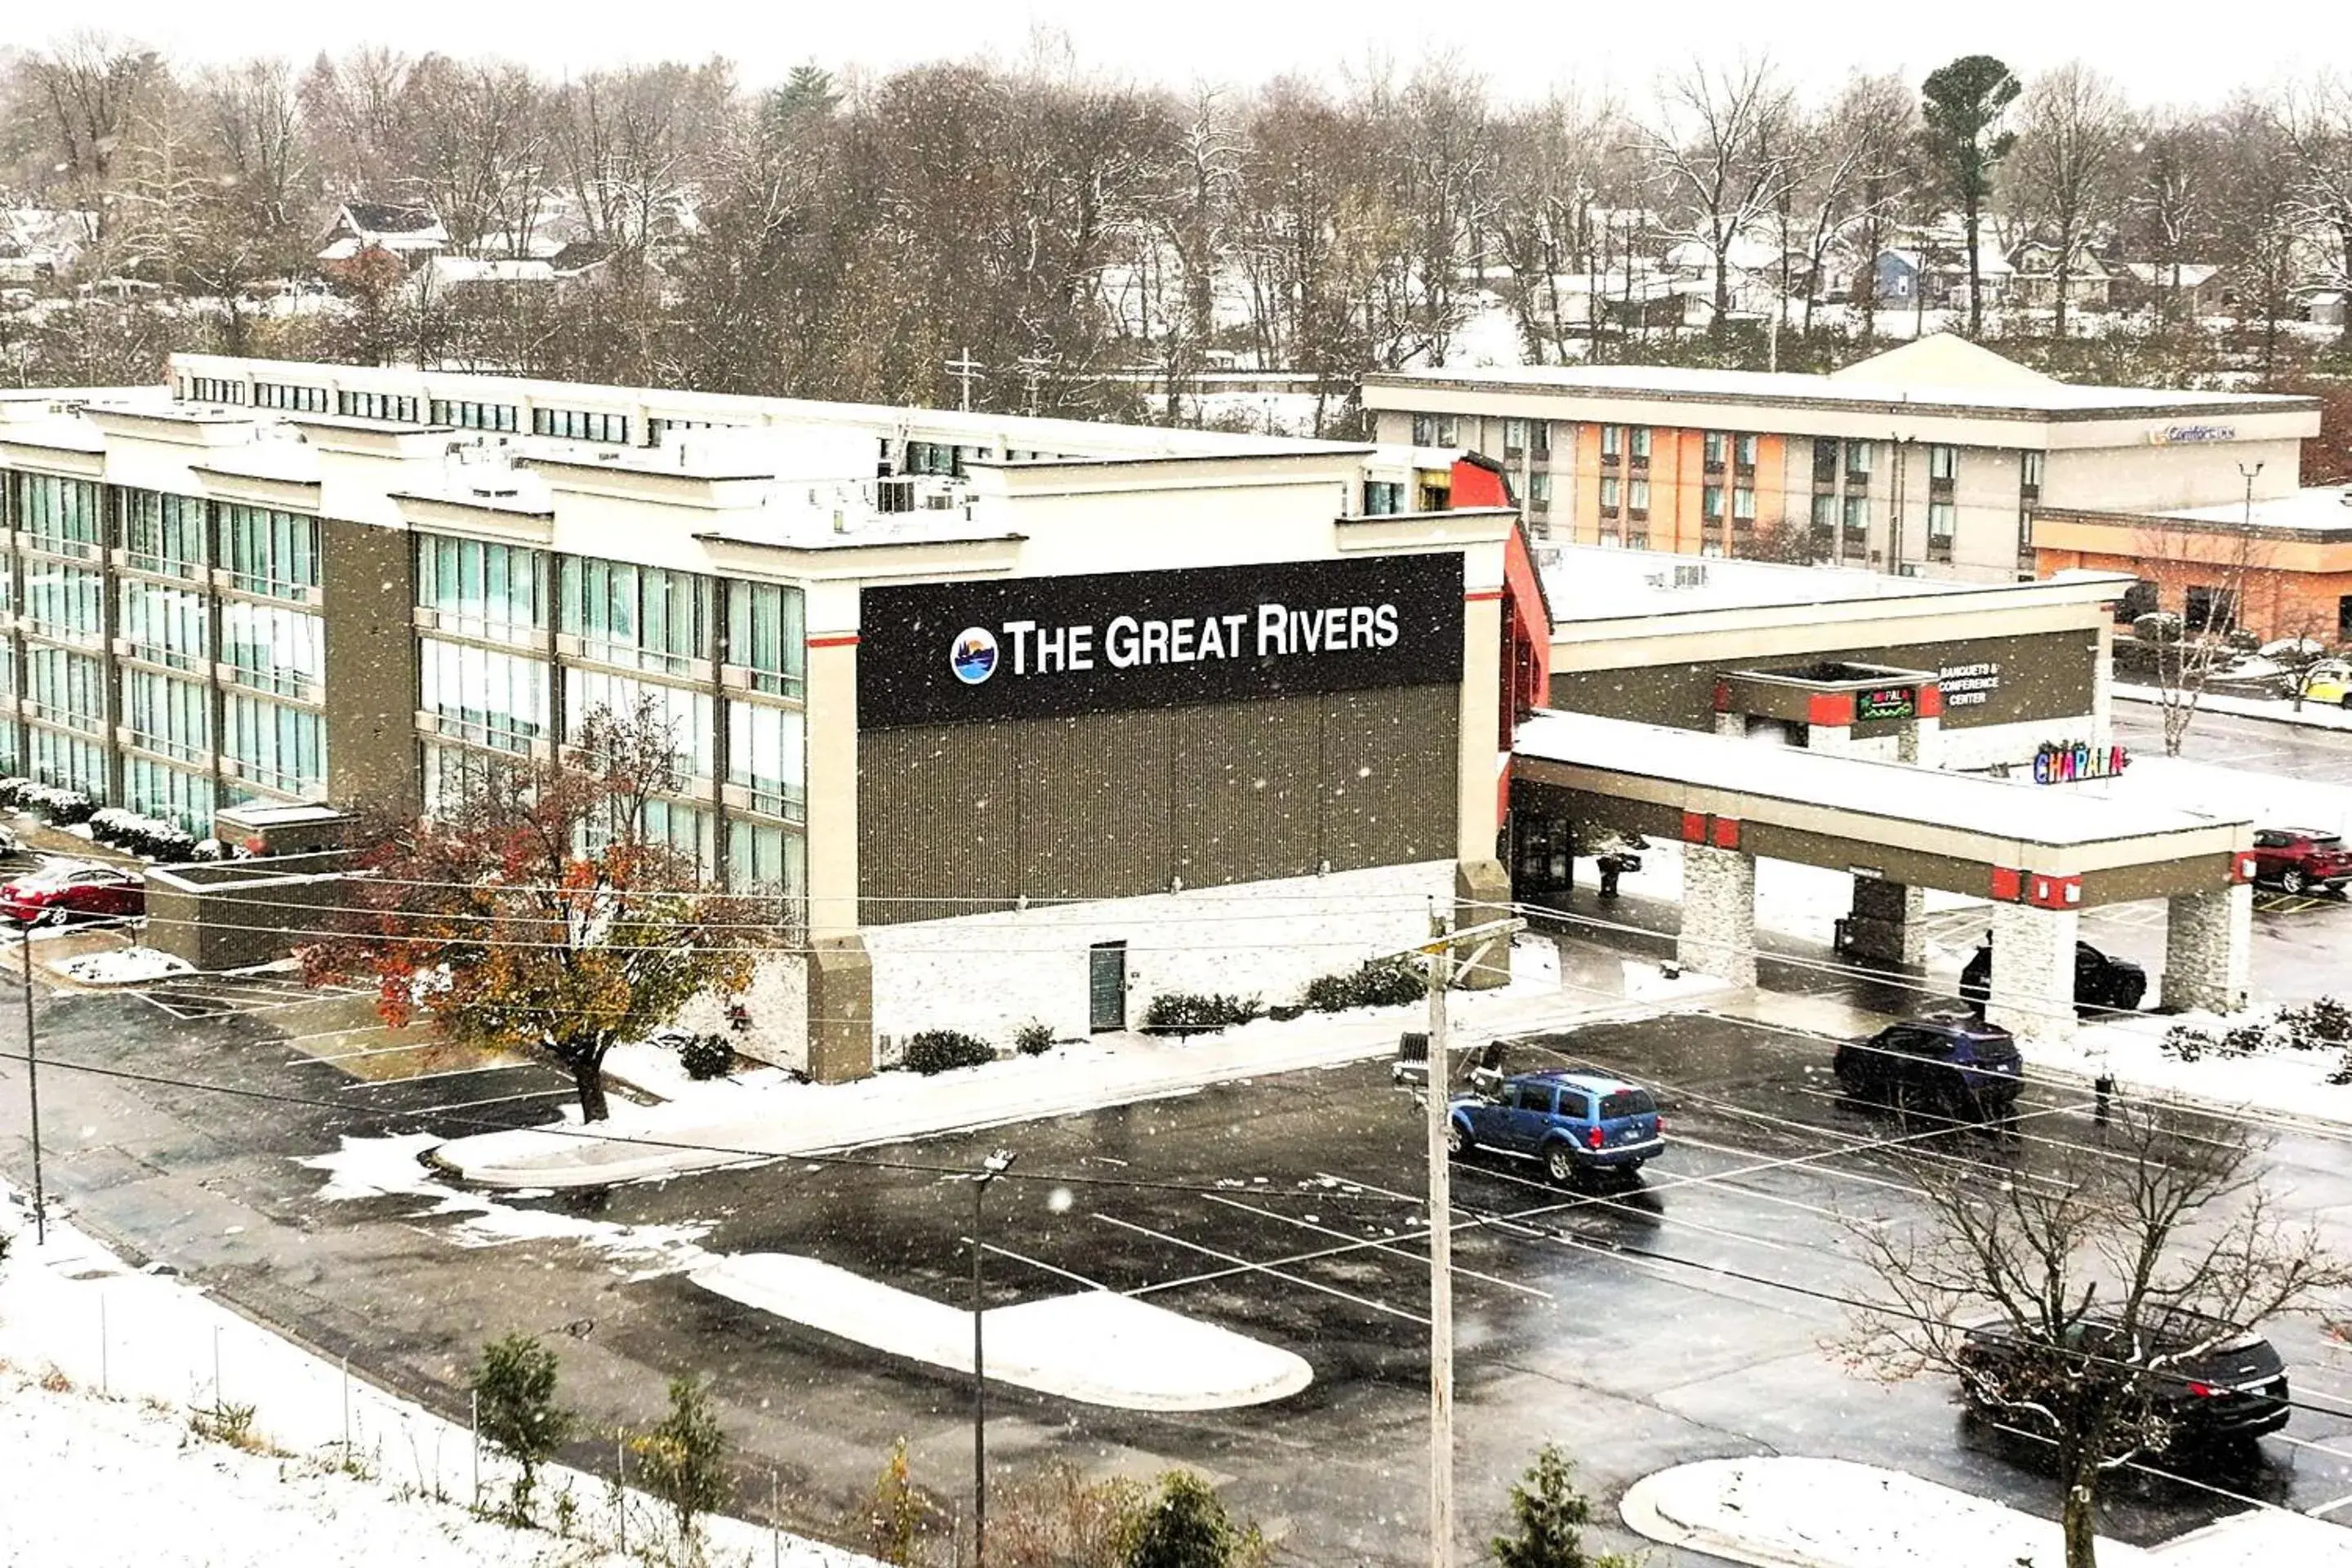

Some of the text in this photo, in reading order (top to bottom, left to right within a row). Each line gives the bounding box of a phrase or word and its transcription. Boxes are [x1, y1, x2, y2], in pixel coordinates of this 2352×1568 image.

[1003, 604, 1399, 675] THE GREAT RIVERS
[1940, 662, 1999, 678] BANQUETS &
[1938, 677, 1999, 693] CONFERENCE
[1949, 693, 1986, 706] CENTER
[2034, 746, 2124, 785] CHAPALA
